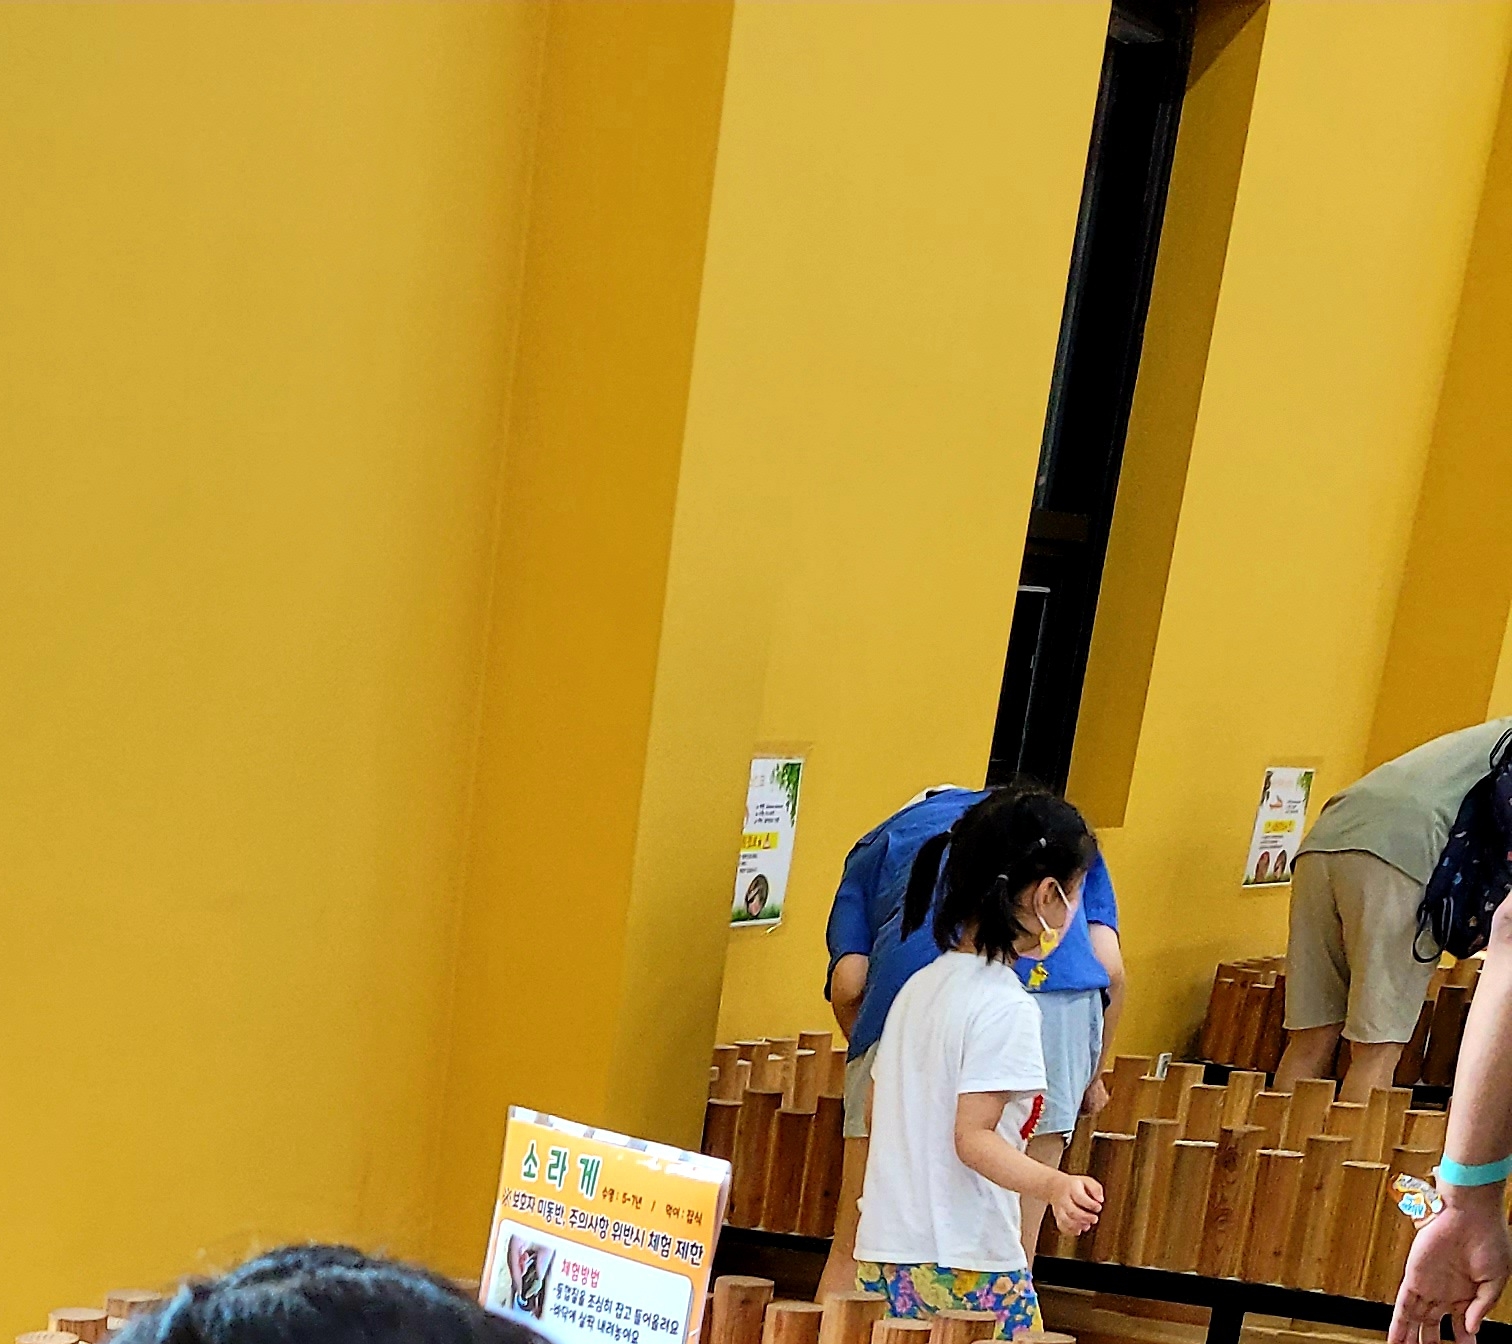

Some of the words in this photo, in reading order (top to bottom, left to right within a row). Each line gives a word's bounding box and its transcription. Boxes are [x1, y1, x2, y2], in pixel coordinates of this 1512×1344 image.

[569, 1208, 609, 1239] 주의사항
[611, 1221, 646, 1248] 위반시
[647, 1231, 672, 1258] 체험
[674, 1240, 704, 1266] 제한
[561, 1258, 601, 1289] 체험방법
[587, 1293, 614, 1314] 조심히
[615, 1301, 632, 1320] 잡고
